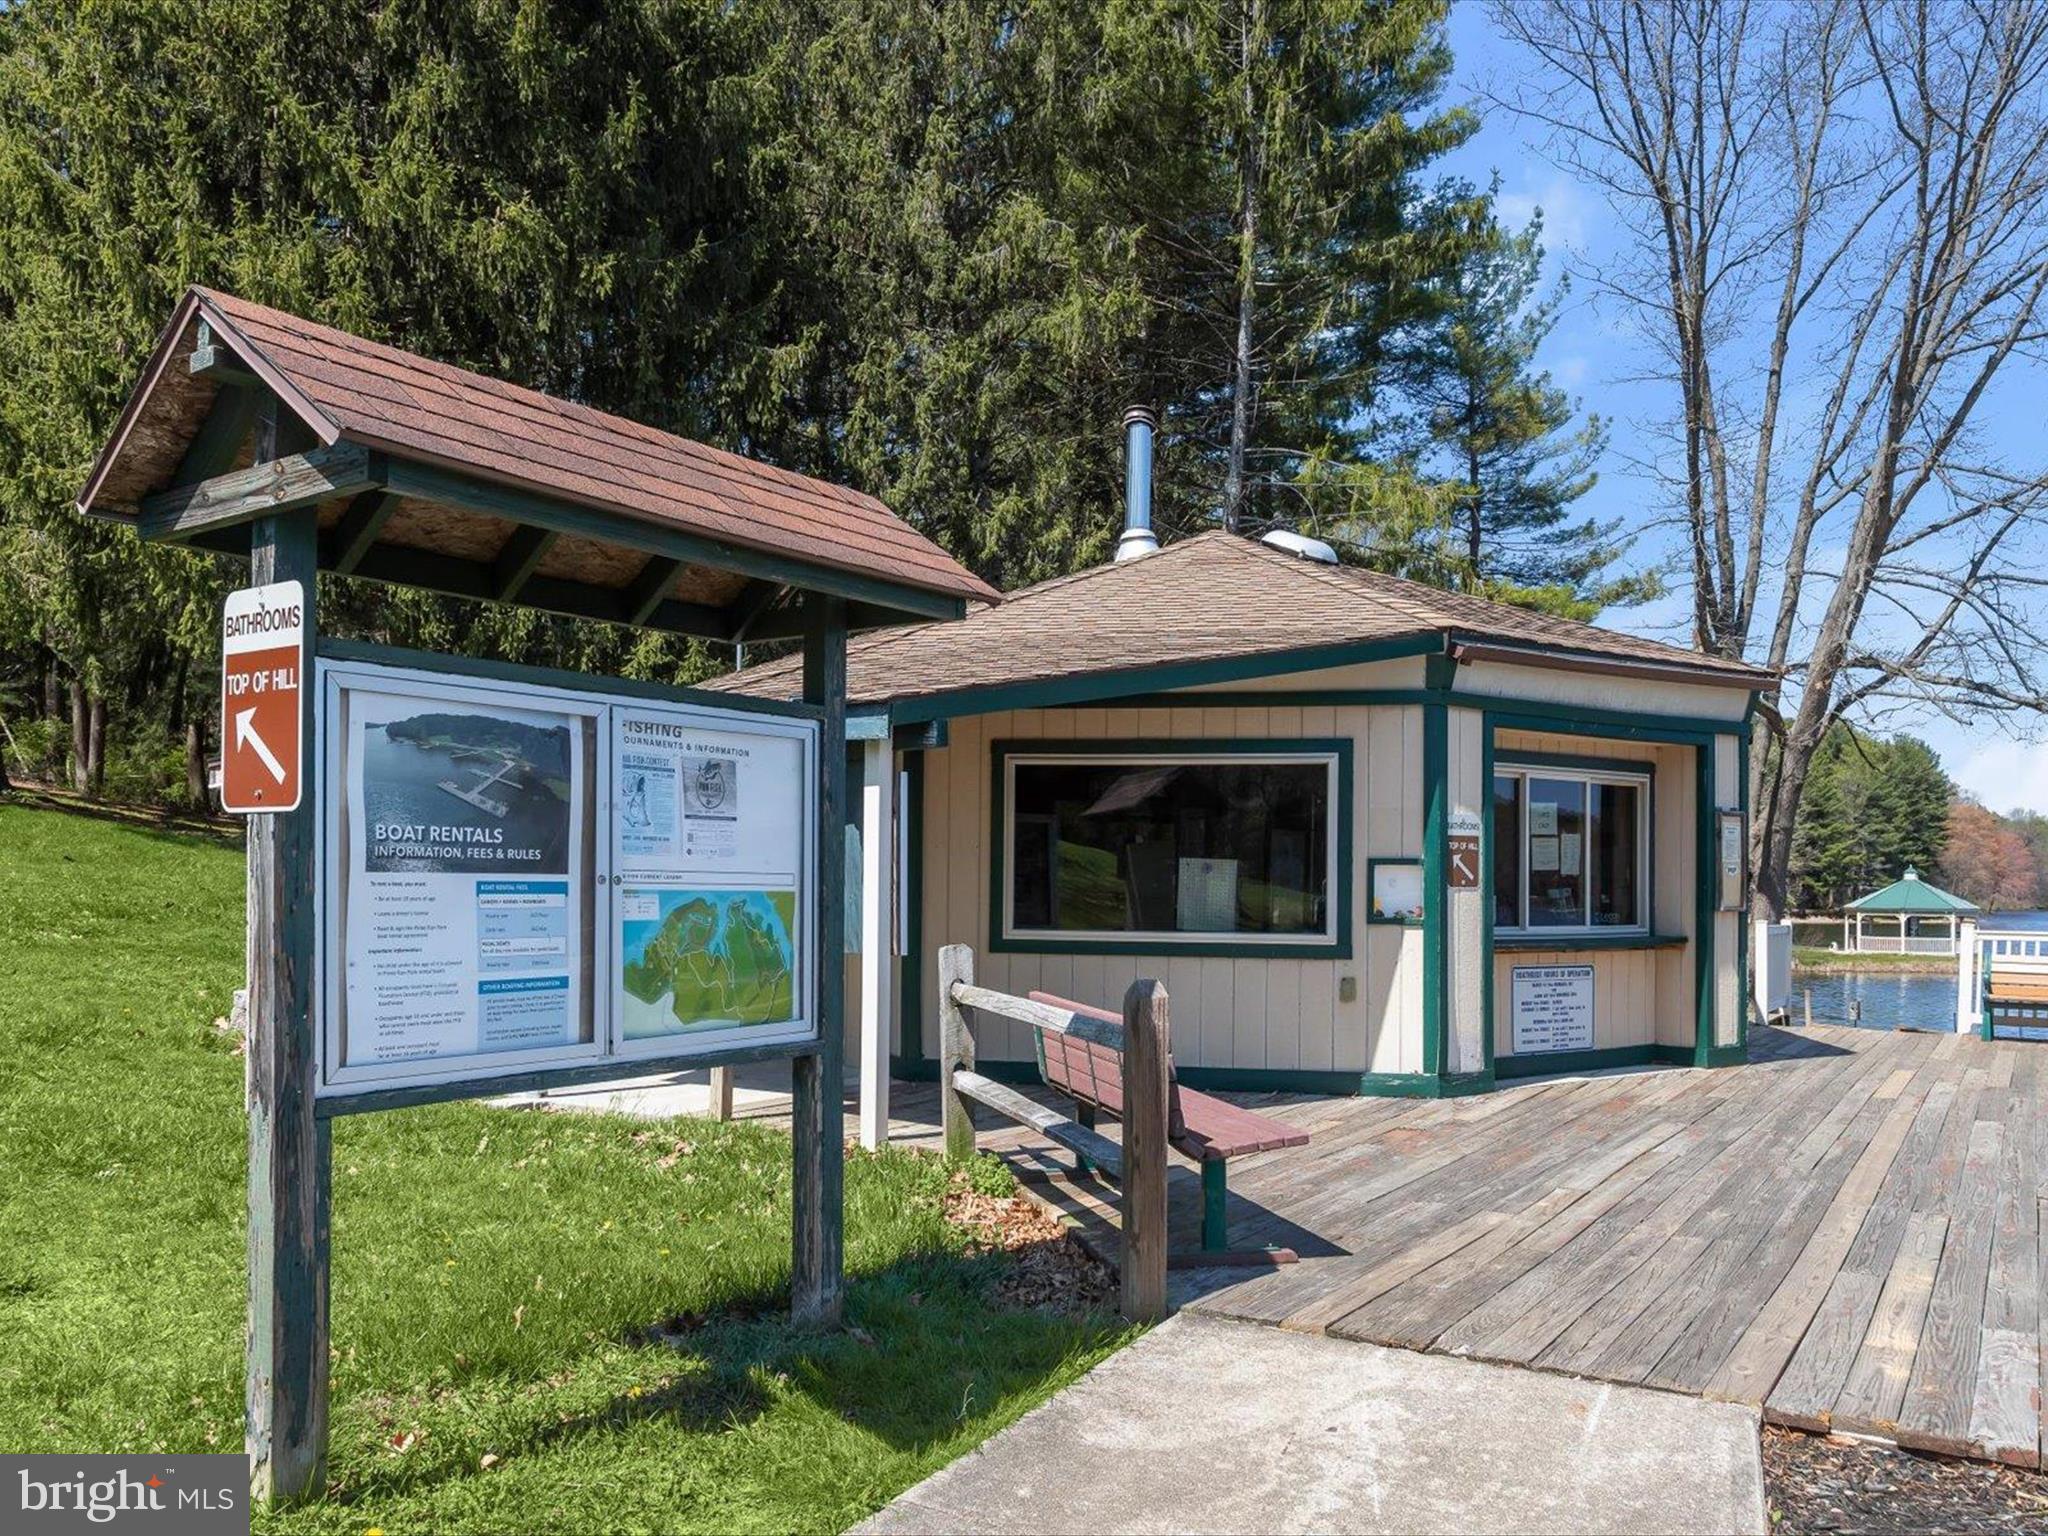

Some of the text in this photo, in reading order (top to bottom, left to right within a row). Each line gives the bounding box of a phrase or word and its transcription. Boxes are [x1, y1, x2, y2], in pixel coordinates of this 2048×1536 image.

[226, 605, 300, 638] BATHROOMS
[227, 668, 297, 695] TOP OF HILL
[623, 736, 750, 757] OURNAMENTS & INFORMATION
[375, 824, 503, 843] BOAT RENTALS
[375, 846, 541, 860] INFORMATION, FEES & RULES
